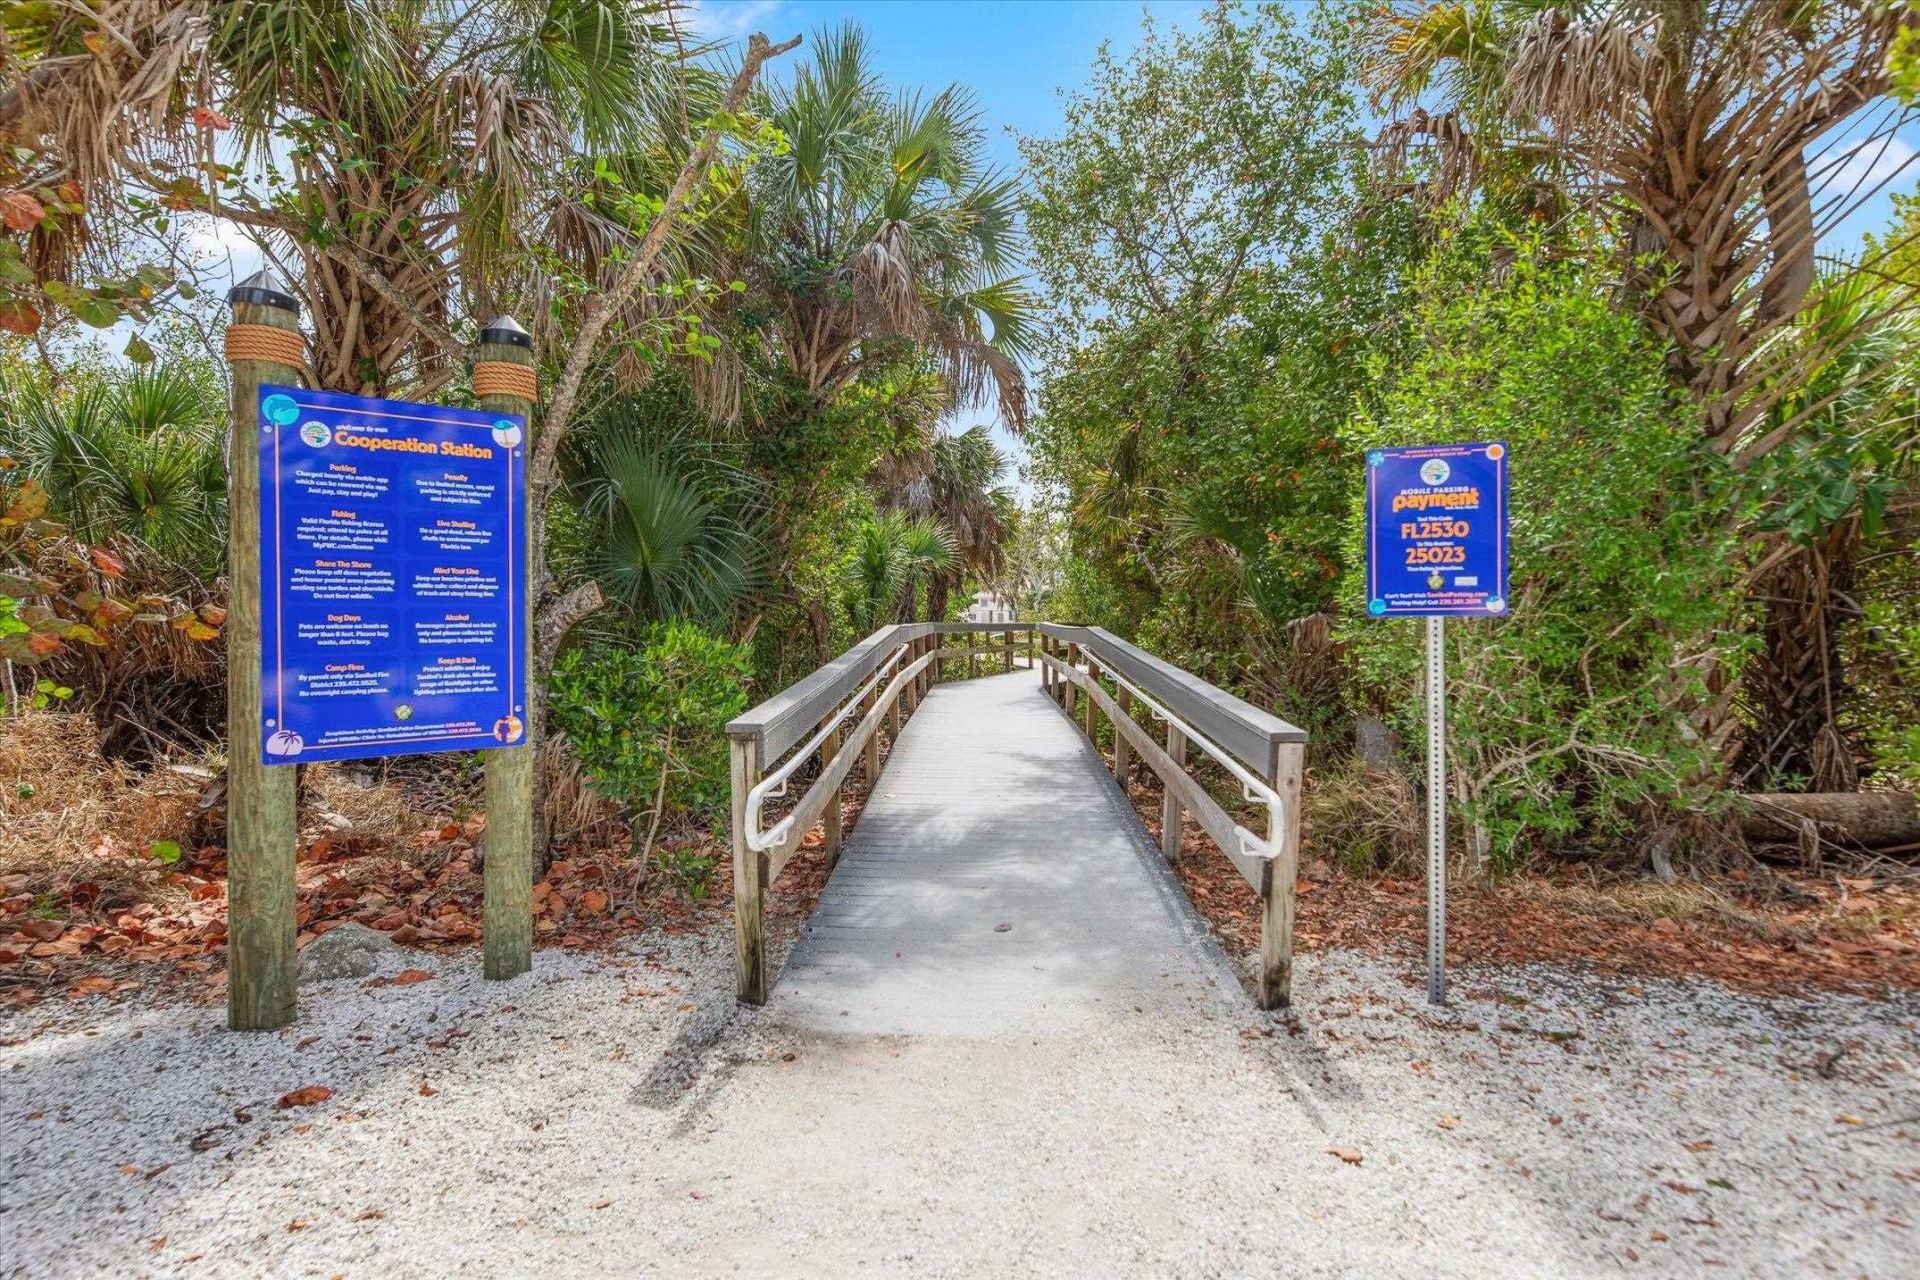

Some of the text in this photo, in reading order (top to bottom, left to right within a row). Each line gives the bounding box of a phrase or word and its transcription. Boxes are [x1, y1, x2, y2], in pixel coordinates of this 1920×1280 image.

[335, 430, 437, 454] Cooperation
[441, 441, 492, 459] Station
[330, 464, 356, 474] Parking
[445, 474, 468, 482] Penalty
[1393, 488, 1479, 513] payment
[332, 510, 355, 519] Fishing
[452, 521, 475, 530] Shelling
[1402, 521, 1470, 539] FL2530
[1406, 547, 1465, 564] 25023
